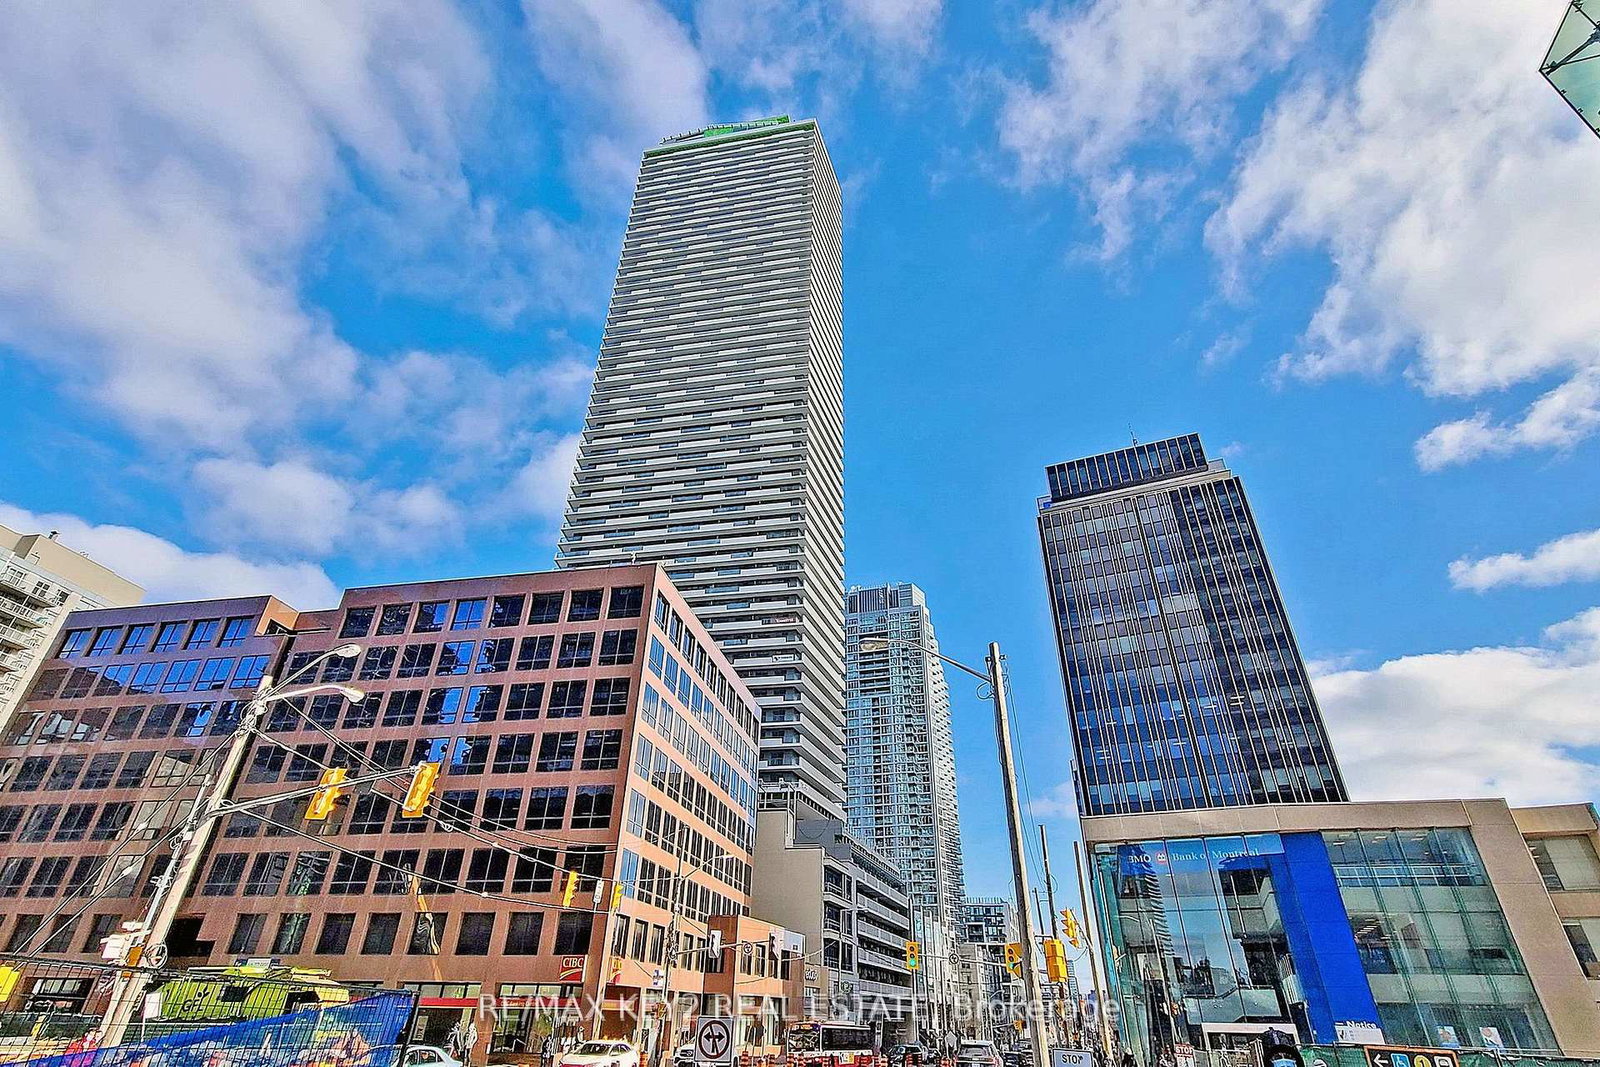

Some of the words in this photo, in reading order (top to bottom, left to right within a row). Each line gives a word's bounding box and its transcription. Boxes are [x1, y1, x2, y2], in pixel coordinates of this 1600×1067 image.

[1171, 851, 1199, 861] Bank
[1211, 848, 1260, 859] Montreal
[562, 957, 584, 968] CIBC
[182, 999, 204, 1012] GFL
[1346, 1020, 1377, 1029] Notice
[1175, 1046, 1194, 1054] STOP
[1061, 1054, 1084, 1065] STOP
